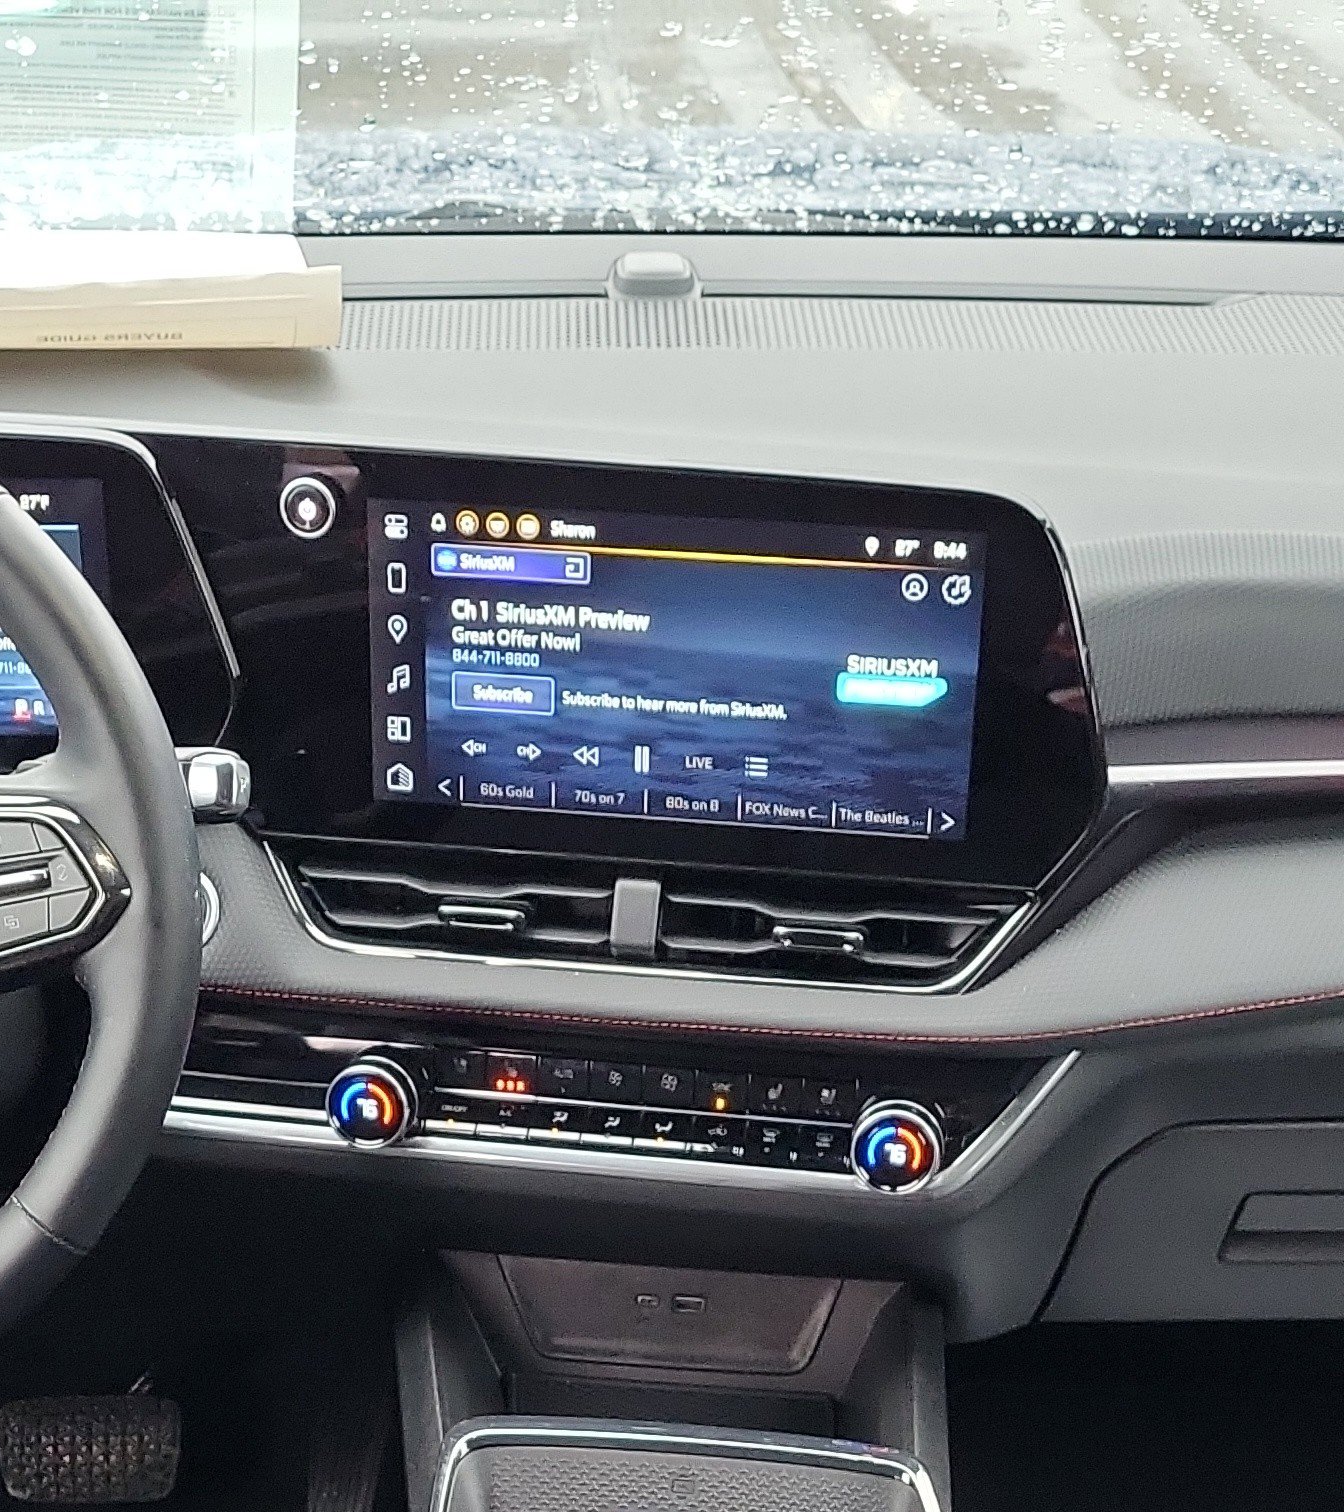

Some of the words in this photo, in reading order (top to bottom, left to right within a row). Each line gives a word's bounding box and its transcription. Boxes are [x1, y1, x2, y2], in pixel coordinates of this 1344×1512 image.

[459, 552, 515, 572] SiriusXM
[451, 598, 478, 621] Ch
[496, 601, 576, 628] SiriusXM
[579, 605, 651, 632] Preview
[451, 625, 494, 647] Great
[496, 628, 539, 649] Offer
[540, 631, 582, 652] Now!
[847, 654, 939, 679] SIRIUSXM
[472, 684, 534, 705] Subscribe
[562, 690, 621, 709] Subscribe
[622, 694, 635, 710] to
[636, 693, 664, 713] hear
[666, 699, 698, 715] more
[699, 698, 729, 716] from
[685, 755, 714, 770] LIVE
[745, 801, 771, 815] FOX
[839, 808, 863, 823] The
[864, 810, 910, 825] Beatles
